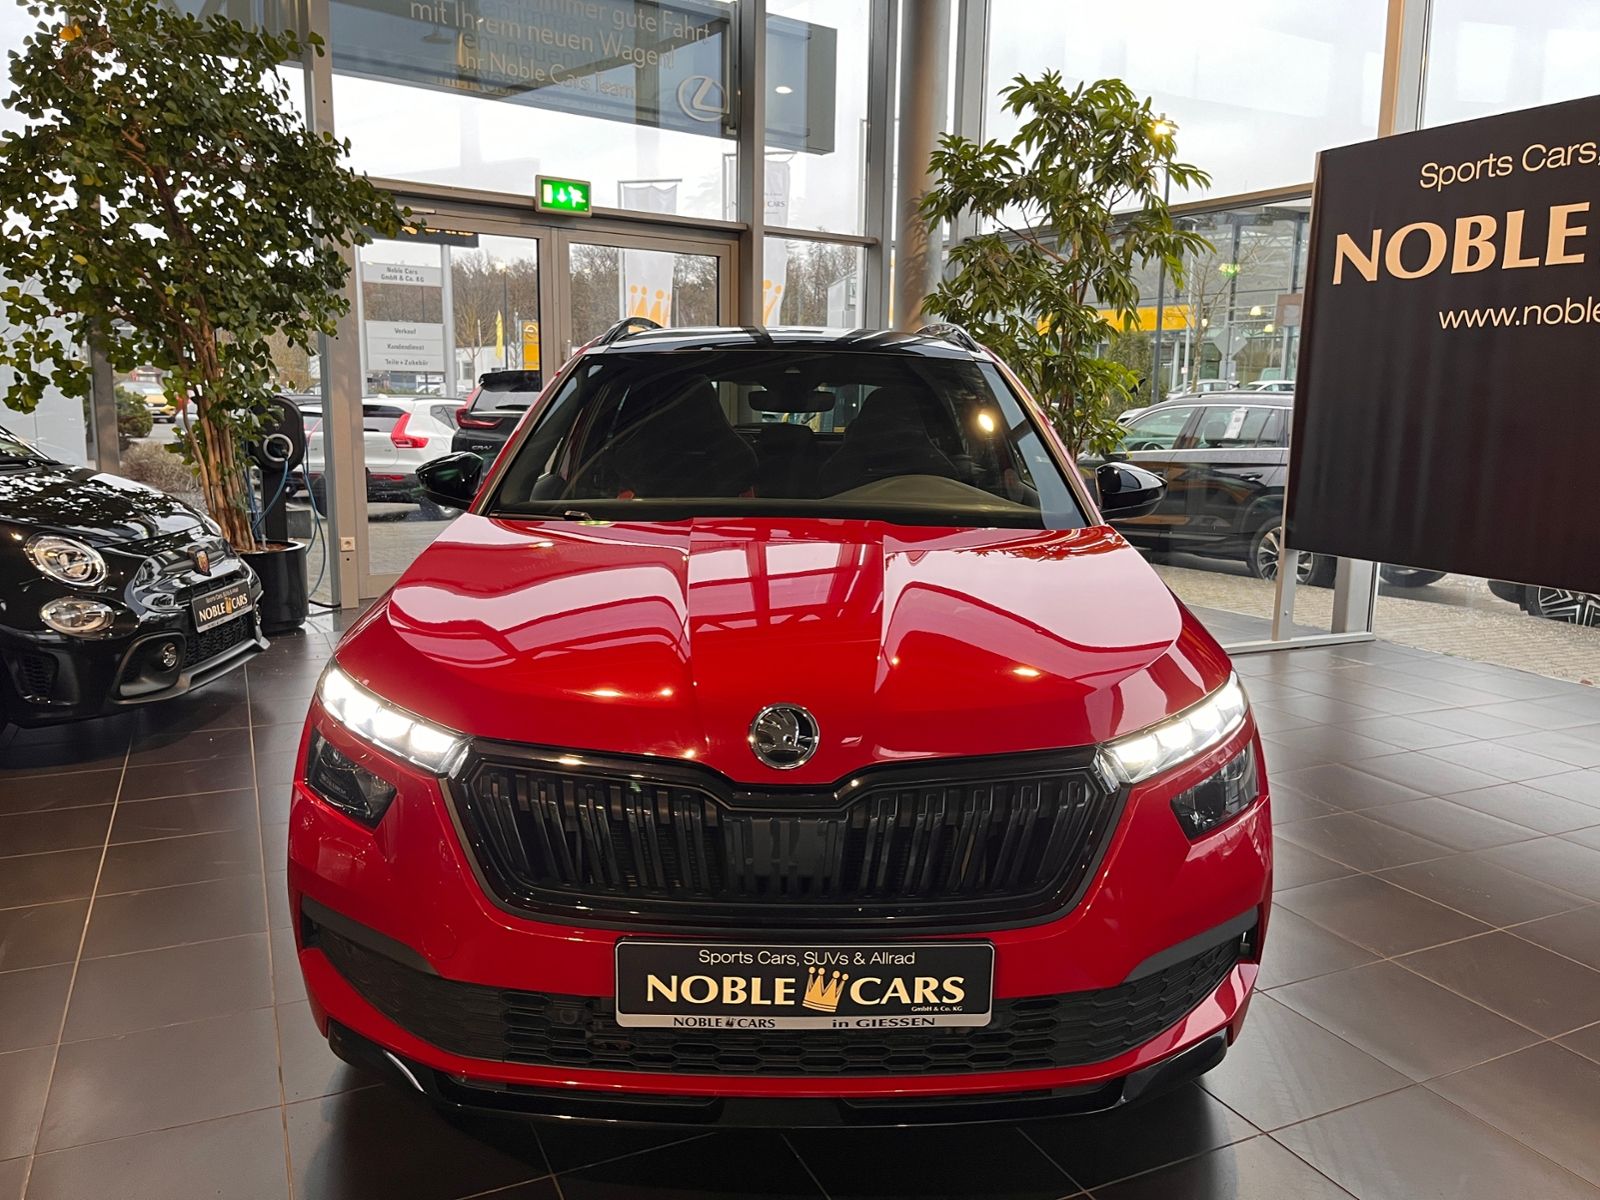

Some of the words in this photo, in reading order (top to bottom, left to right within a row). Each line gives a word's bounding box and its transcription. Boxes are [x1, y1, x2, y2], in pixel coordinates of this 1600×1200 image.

[410, 1, 448, 25] mit
[454, 0, 521, 40] Ihrem
[528, 25, 593, 53] neuen
[600, 31, 675, 69] Wagen!
[613, 9, 657, 32] gute
[663, 10, 711, 45] Fahrt
[490, 51, 545, 82] Noble
[1419, 153, 1513, 192] Sports
[1332, 201, 1590, 286] NOBLE
[198, 602, 226, 622] NOBLE
[231, 593, 248, 609] CARS
[698, 949, 754, 966] Sports
[757, 950, 801, 967] Cars,
[803, 951, 849, 966] SUVs
[853, 952, 866, 965] &
[869, 951, 916, 965] Allrad
[646, 974, 796, 1006] NOBLE
[849, 976, 966, 1005] CARS
[673, 1017, 722, 1028] NOBLE
[737, 1018, 776, 1029] CARS
[832, 1019, 849, 1028] in
[855, 1017, 936, 1028] GIESSEN
